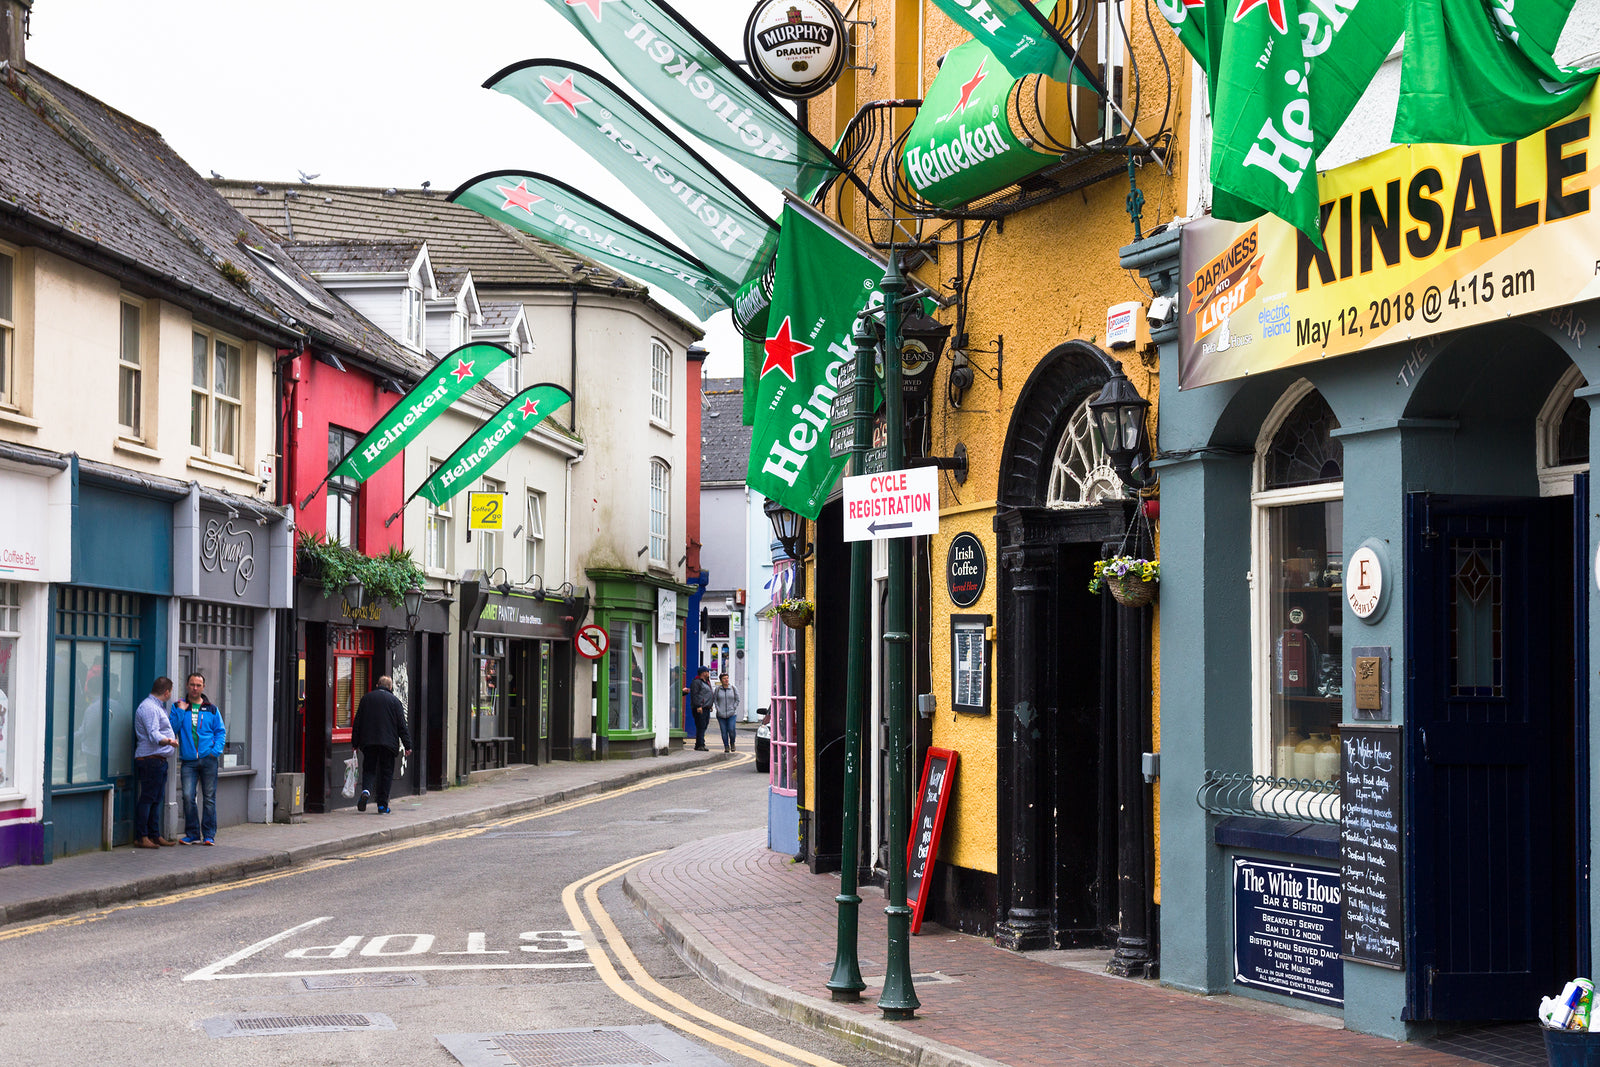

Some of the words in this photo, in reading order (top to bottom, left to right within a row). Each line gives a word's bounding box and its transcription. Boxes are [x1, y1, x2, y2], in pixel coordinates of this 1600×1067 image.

[763, 25, 829, 47] MURPHY'S
[776, 46, 822, 57] DRAUGHT
[907, 120, 1010, 191] Heineken
[1296, 114, 1590, 292] KINSALE
[1196, 231, 1257, 297] DARKNESS
[1201, 276, 1249, 334] LIGHT
[1258, 301, 1290, 324] electric
[1296, 317, 1332, 348] May
[1337, 306, 1364, 337] 12,
[1369, 291, 1415, 330] 2018
[1421, 285, 1443, 324] @
[1448, 271, 1495, 310] 4:15
[1501, 268, 1535, 299] am
[809, 316, 825, 340] MARK
[1262, 315, 1291, 339] Ireland
[1230, 333, 1253, 348] House
[901, 351, 933, 361] REAN'S
[1398, 339, 1428, 388] THE
[769, 385, 787, 412] TRADE
[362, 385, 448, 463] Heineken
[440, 419, 516, 488] Heineken
[870, 473, 908, 494] CYCLE
[481, 500, 498, 524] 2
[849, 493, 931, 519] REGISTRATION
[3, 548, 24, 564] Coffee
[25, 551, 36, 566] Bar
[955, 546, 974, 561] Irish
[952, 561, 978, 577] Coffee
[1357, 559, 1371, 590] E
[952, 581, 966, 593] Served
[966, 581, 978, 591] Here
[497, 604, 515, 622] PANTRY
[1343, 736, 1356, 764] The
[1356, 736, 1374, 767] White
[1374, 741, 1391, 766] House
[1363, 773, 1375, 786] Food
[1347, 846, 1366, 862] Seafood
[1242, 867, 1265, 893] The
[1267, 871, 1303, 899] White
[1306, 876, 1341, 905] Hous
[1346, 881, 1365, 895] Seafood
[1262, 894, 1280, 907] BAR
[1282, 898, 1290, 909] &
[1292, 898, 1324, 914] BISTRO
[1348, 896, 1358, 908] Full
[1262, 913, 1297, 927] BREAKFAST
[1298, 919, 1325, 932] SERVED
[1265, 923, 1279, 934] 8AM
[1281, 927, 1289, 936] TO
[1292, 928, 1301, 938] 12
[1302, 931, 1321, 942] NOON
[284, 928, 592, 959] STOP
[1344, 929, 1354, 940] Live
[1249, 935, 1272, 947] BISTRO
[1273, 939, 1292, 951] MENU
[1293, 943, 1319, 956] SERVED
[1320, 949, 1339, 960] DAILY
[1264, 948, 1273, 957] 12
[1274, 951, 1293, 961] NOON
[1294, 954, 1303, 963] TO
[1305, 956, 1324, 967] 10PM
[1255, 966, 1269, 974] RELAX
[1285, 973, 1303, 982] MODERN
[1315, 980, 1334, 988] GARDEN
[1275, 960, 1290, 971] LIVE
[1291, 963, 1312, 975] MUSIC
[1259, 973, 1268, 981] ALL
[1268, 976, 1289, 986] SPORTING
[1289, 980, 1306, 989] EVENTS
[1306, 984, 1330, 995] TELEVISED
